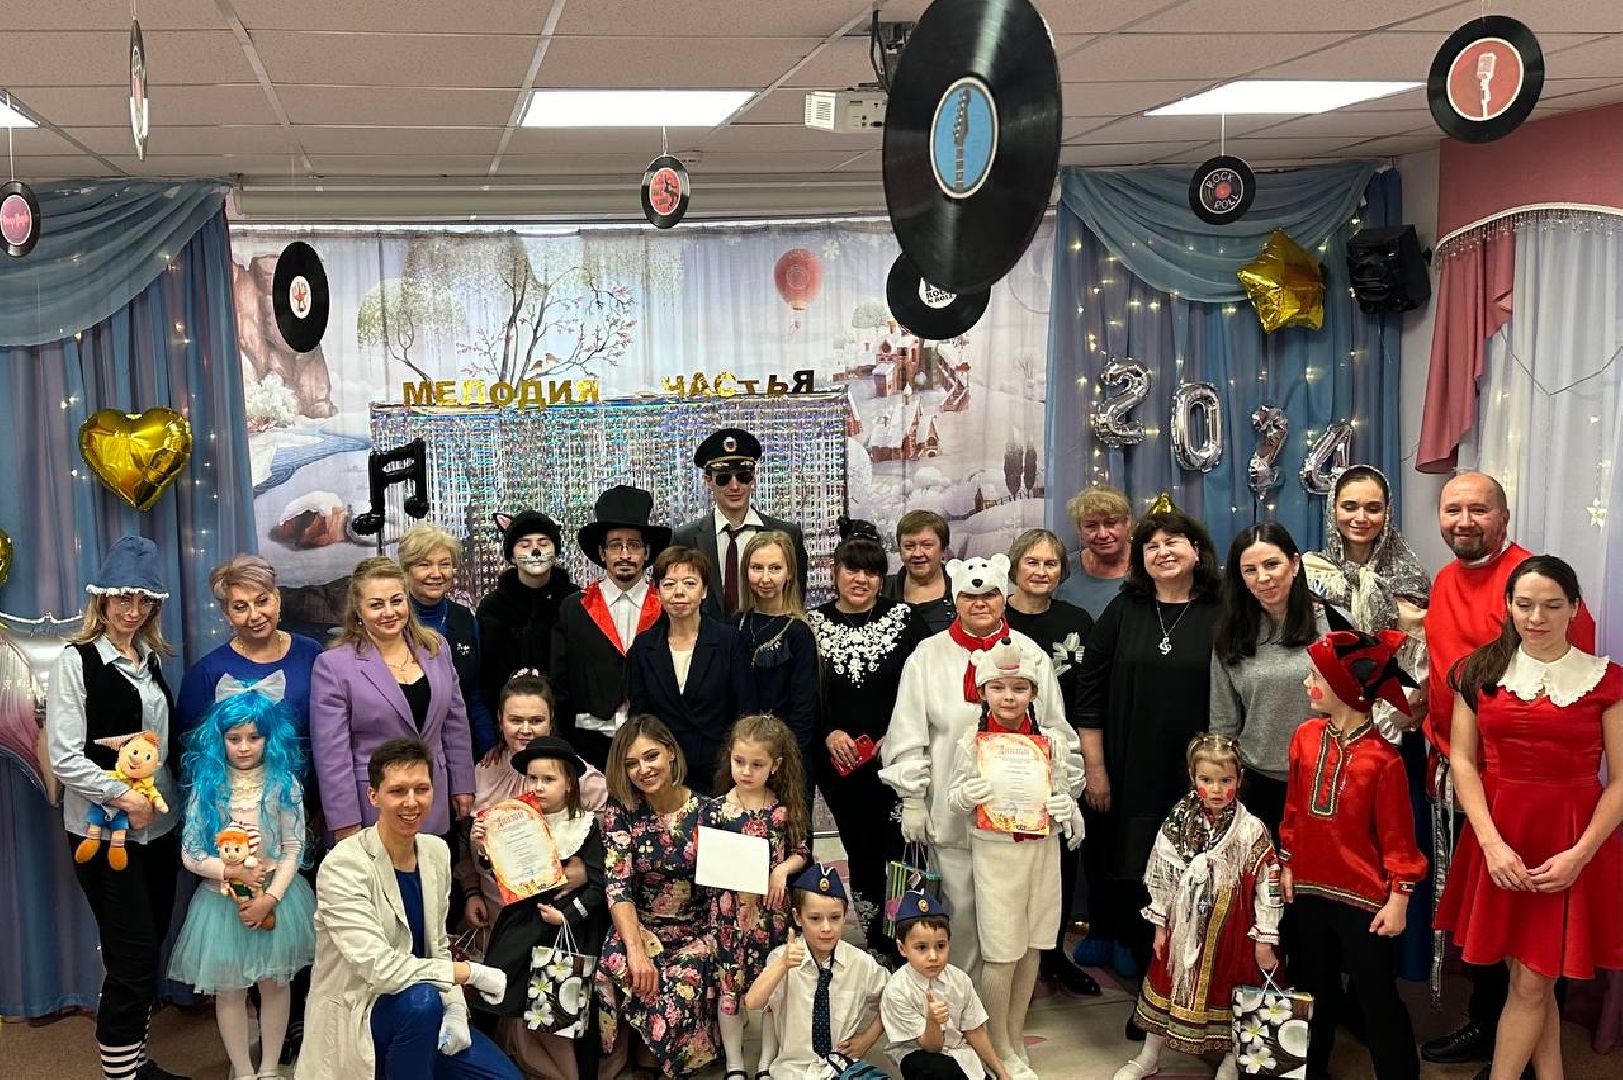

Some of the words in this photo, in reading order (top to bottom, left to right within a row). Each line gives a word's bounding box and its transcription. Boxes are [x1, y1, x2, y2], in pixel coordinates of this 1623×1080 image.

[402, 378, 599, 411] МЕЛОДИЯ
[636, 369, 815, 399] ЧАСТЬЯ
[1095, 356, 1353, 500] 2024
